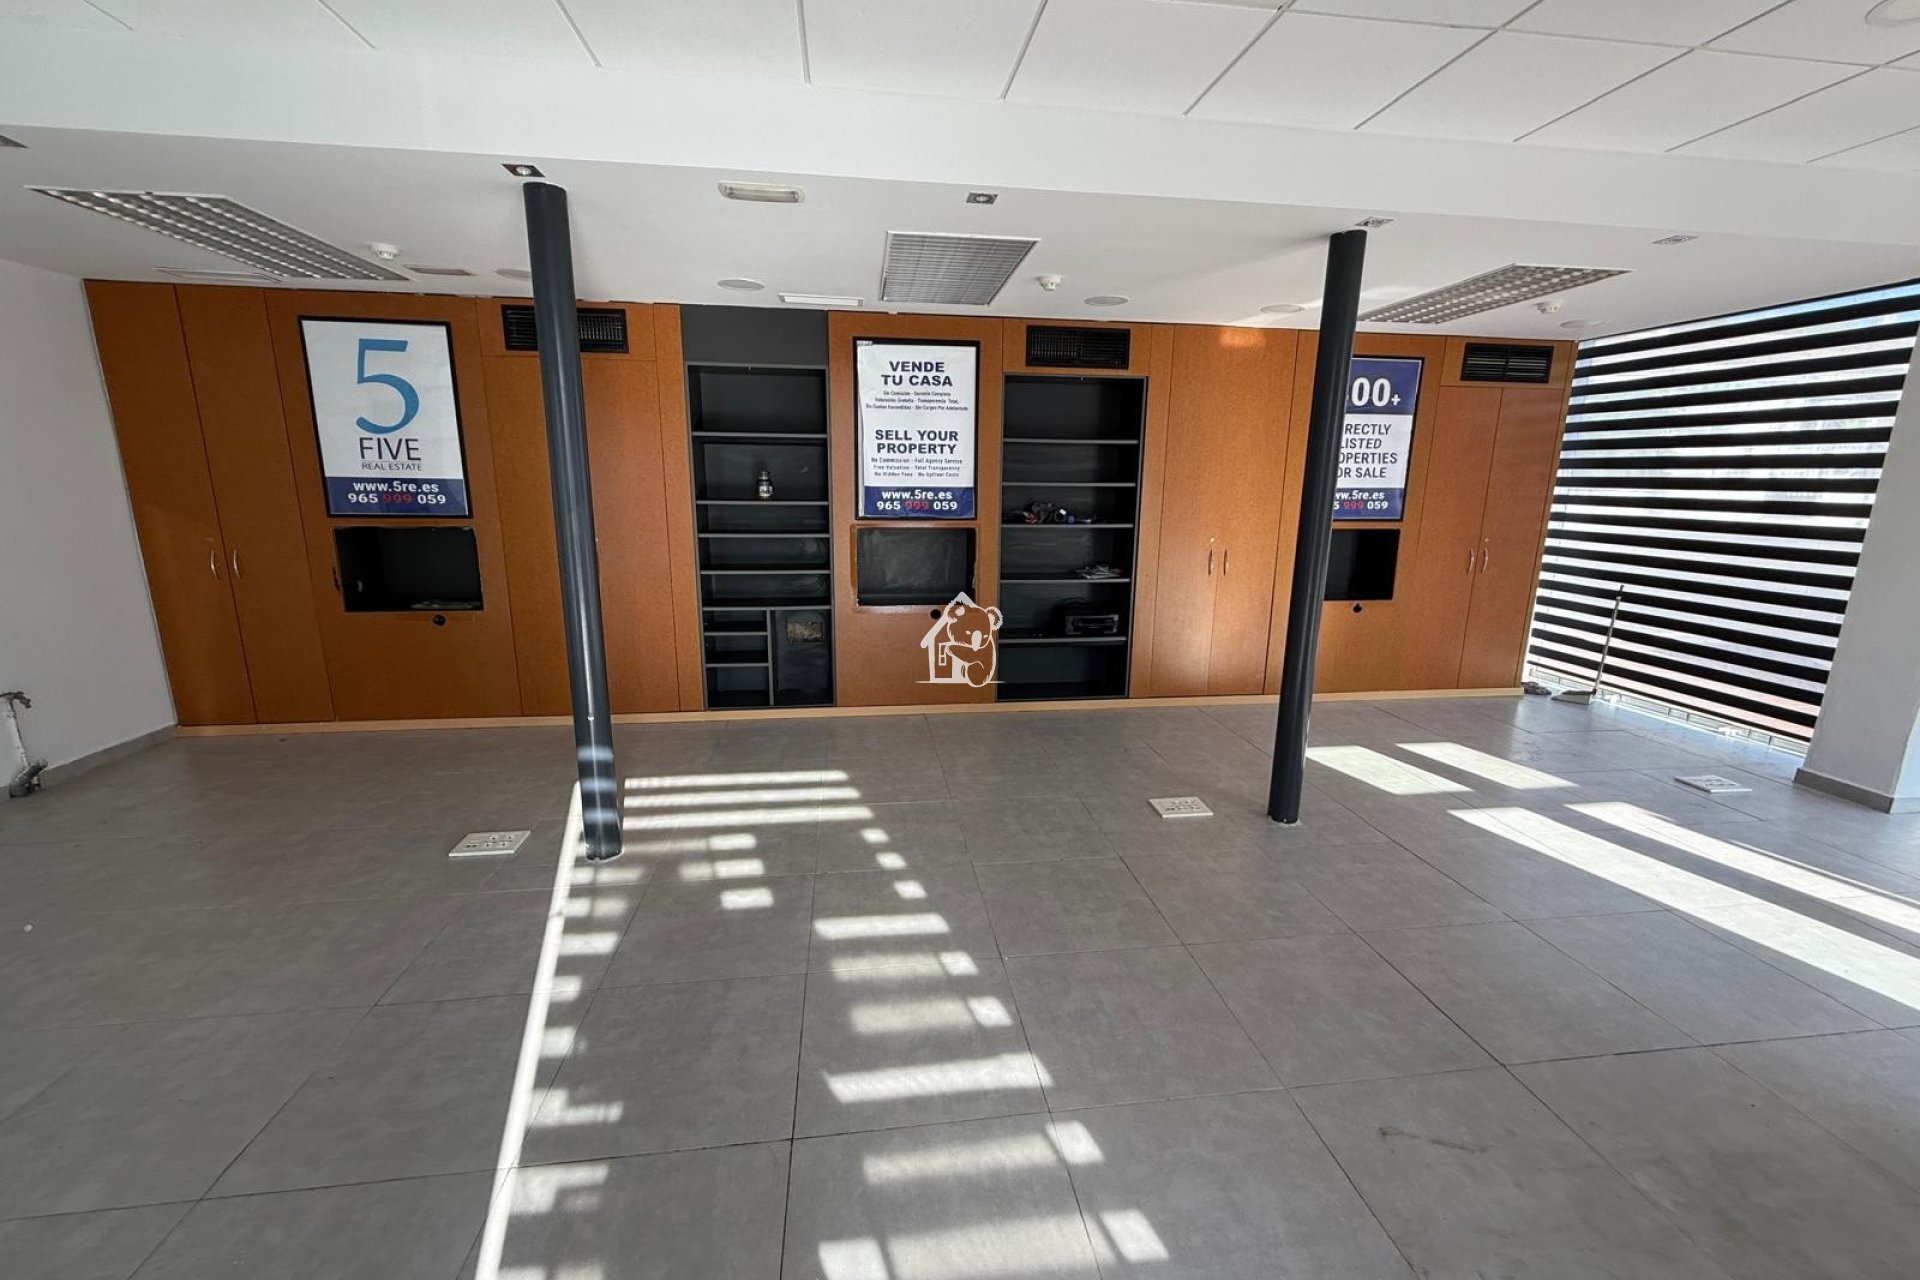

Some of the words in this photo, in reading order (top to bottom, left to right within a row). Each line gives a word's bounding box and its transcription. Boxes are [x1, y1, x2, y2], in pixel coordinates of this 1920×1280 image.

[889, 361, 946, 373] VENDE
[356, 338, 420, 434] 5
[881, 374, 903, 386] TU
[908, 375, 953, 387] CASA
[1347, 377, 1400, 407] 00+
[875, 429, 912, 441] SELL
[917, 430, 959, 441] YOUR
[1344, 424, 1391, 435] RECTLY
[359, 437, 421, 461] FIVE
[877, 443, 957, 454] PROPERTY
[1338, 452, 1398, 464] OPERTIES
[361, 462, 386, 471] REAL
[388, 463, 423, 472] ESTATE
[1337, 467, 1351, 478] OR
[1355, 467, 1387, 478] SALE
[353, 480, 439, 493] www.5re.es
[347, 493, 379, 503] 965
[383, 493, 412, 504] 999
[417, 494, 446, 504] 059
[882, 489, 952, 499] www.5re.es
[1335, 490, 1385, 500] ww.5re.es
[876, 501, 901, 510] 965
[905, 501, 929, 511] 999
[933, 501, 958, 510] 059
[1343, 501, 1364, 510] 999
[1367, 501, 1388, 510] 059
